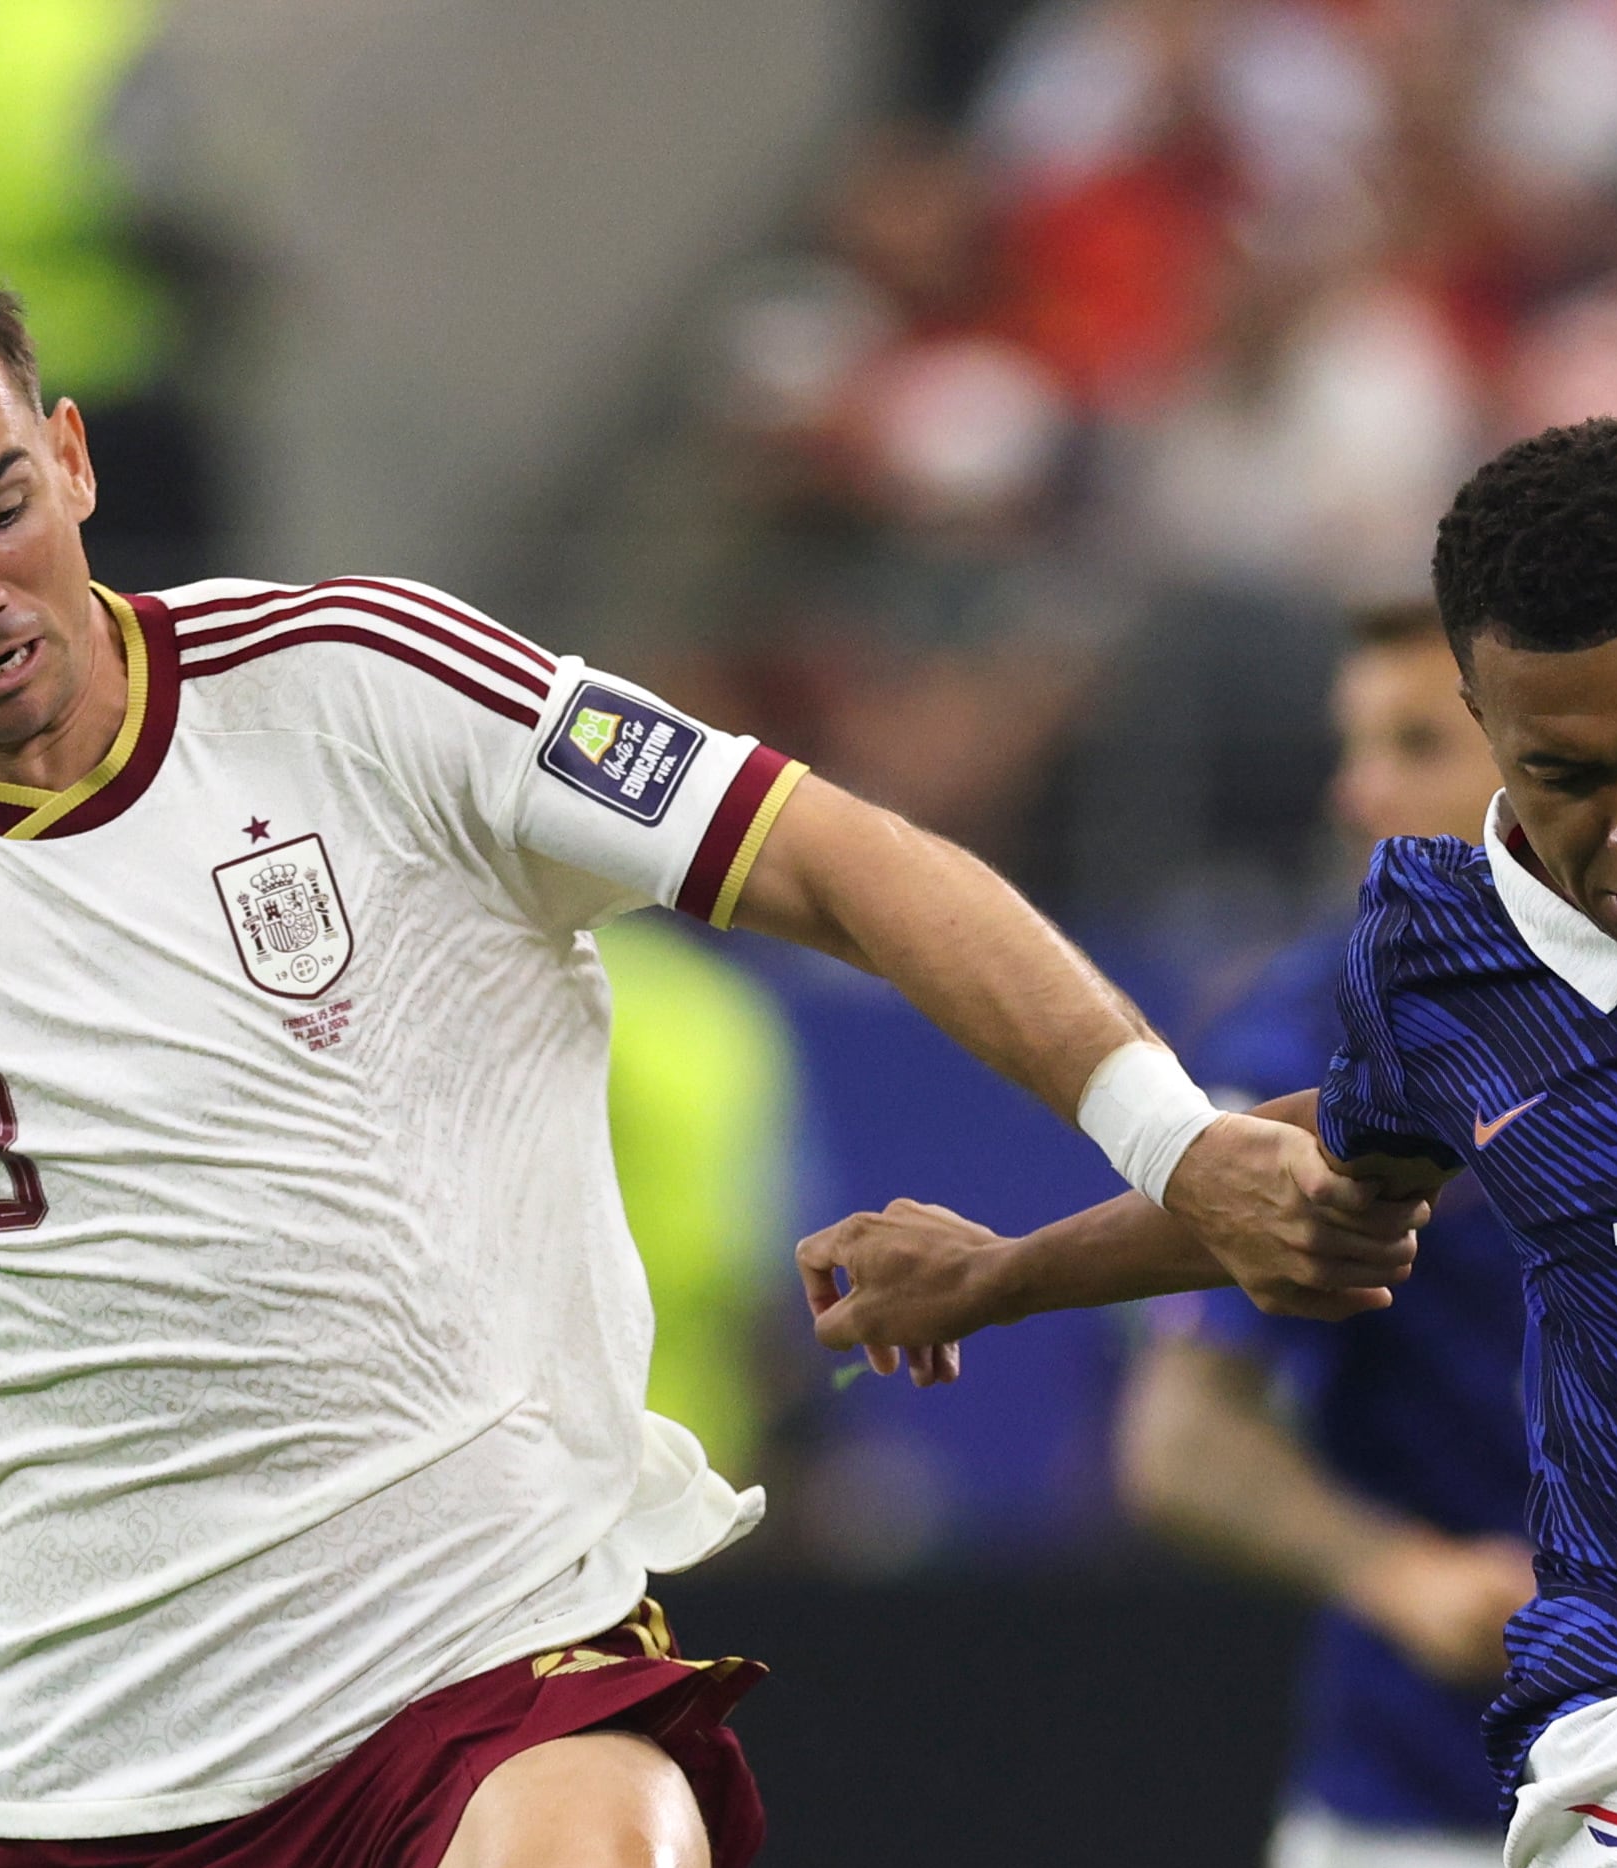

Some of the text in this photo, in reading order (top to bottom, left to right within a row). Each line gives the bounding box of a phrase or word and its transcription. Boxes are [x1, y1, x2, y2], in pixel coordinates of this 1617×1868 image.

[602, 720, 644, 780] Unite For
[620, 721, 676, 800] EDUCATION
[653, 755, 677, 784] FIFA
